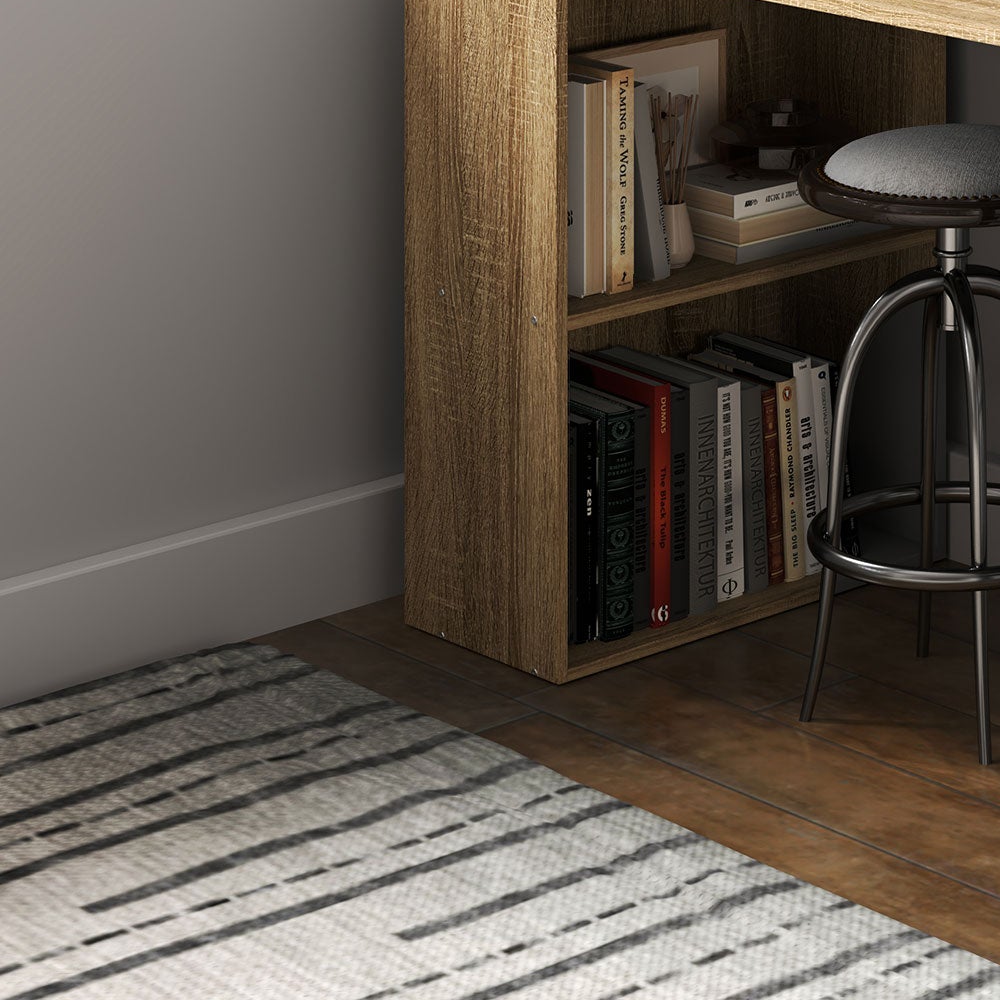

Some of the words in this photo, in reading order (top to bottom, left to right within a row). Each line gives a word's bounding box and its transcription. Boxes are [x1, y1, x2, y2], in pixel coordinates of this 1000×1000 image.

[619, 76, 629, 131] TAMING
[619, 134, 627, 148] the
[619, 148, 629, 188] WOLF
[619, 195, 628, 223] GREG
[620, 224, 628, 256] STONE
[785, 408, 793, 452] CHANDLER
[800, 416, 812, 439] arts
[635, 467, 648, 490] arts
[674, 452, 687, 475] arts
[748, 417, 767, 579] INNENARCHITEKTUR
[803, 454, 817, 519] architecture
[698, 414, 715, 599] INNENARCHITEKTUR
[725, 504, 733, 517] WANT
[725, 517, 733, 525] TO
[635, 507, 648, 574] architecture
[659, 523, 667, 549] Tulip
[674, 492, 687, 562] architecture
[725, 539, 734, 550] Paul
